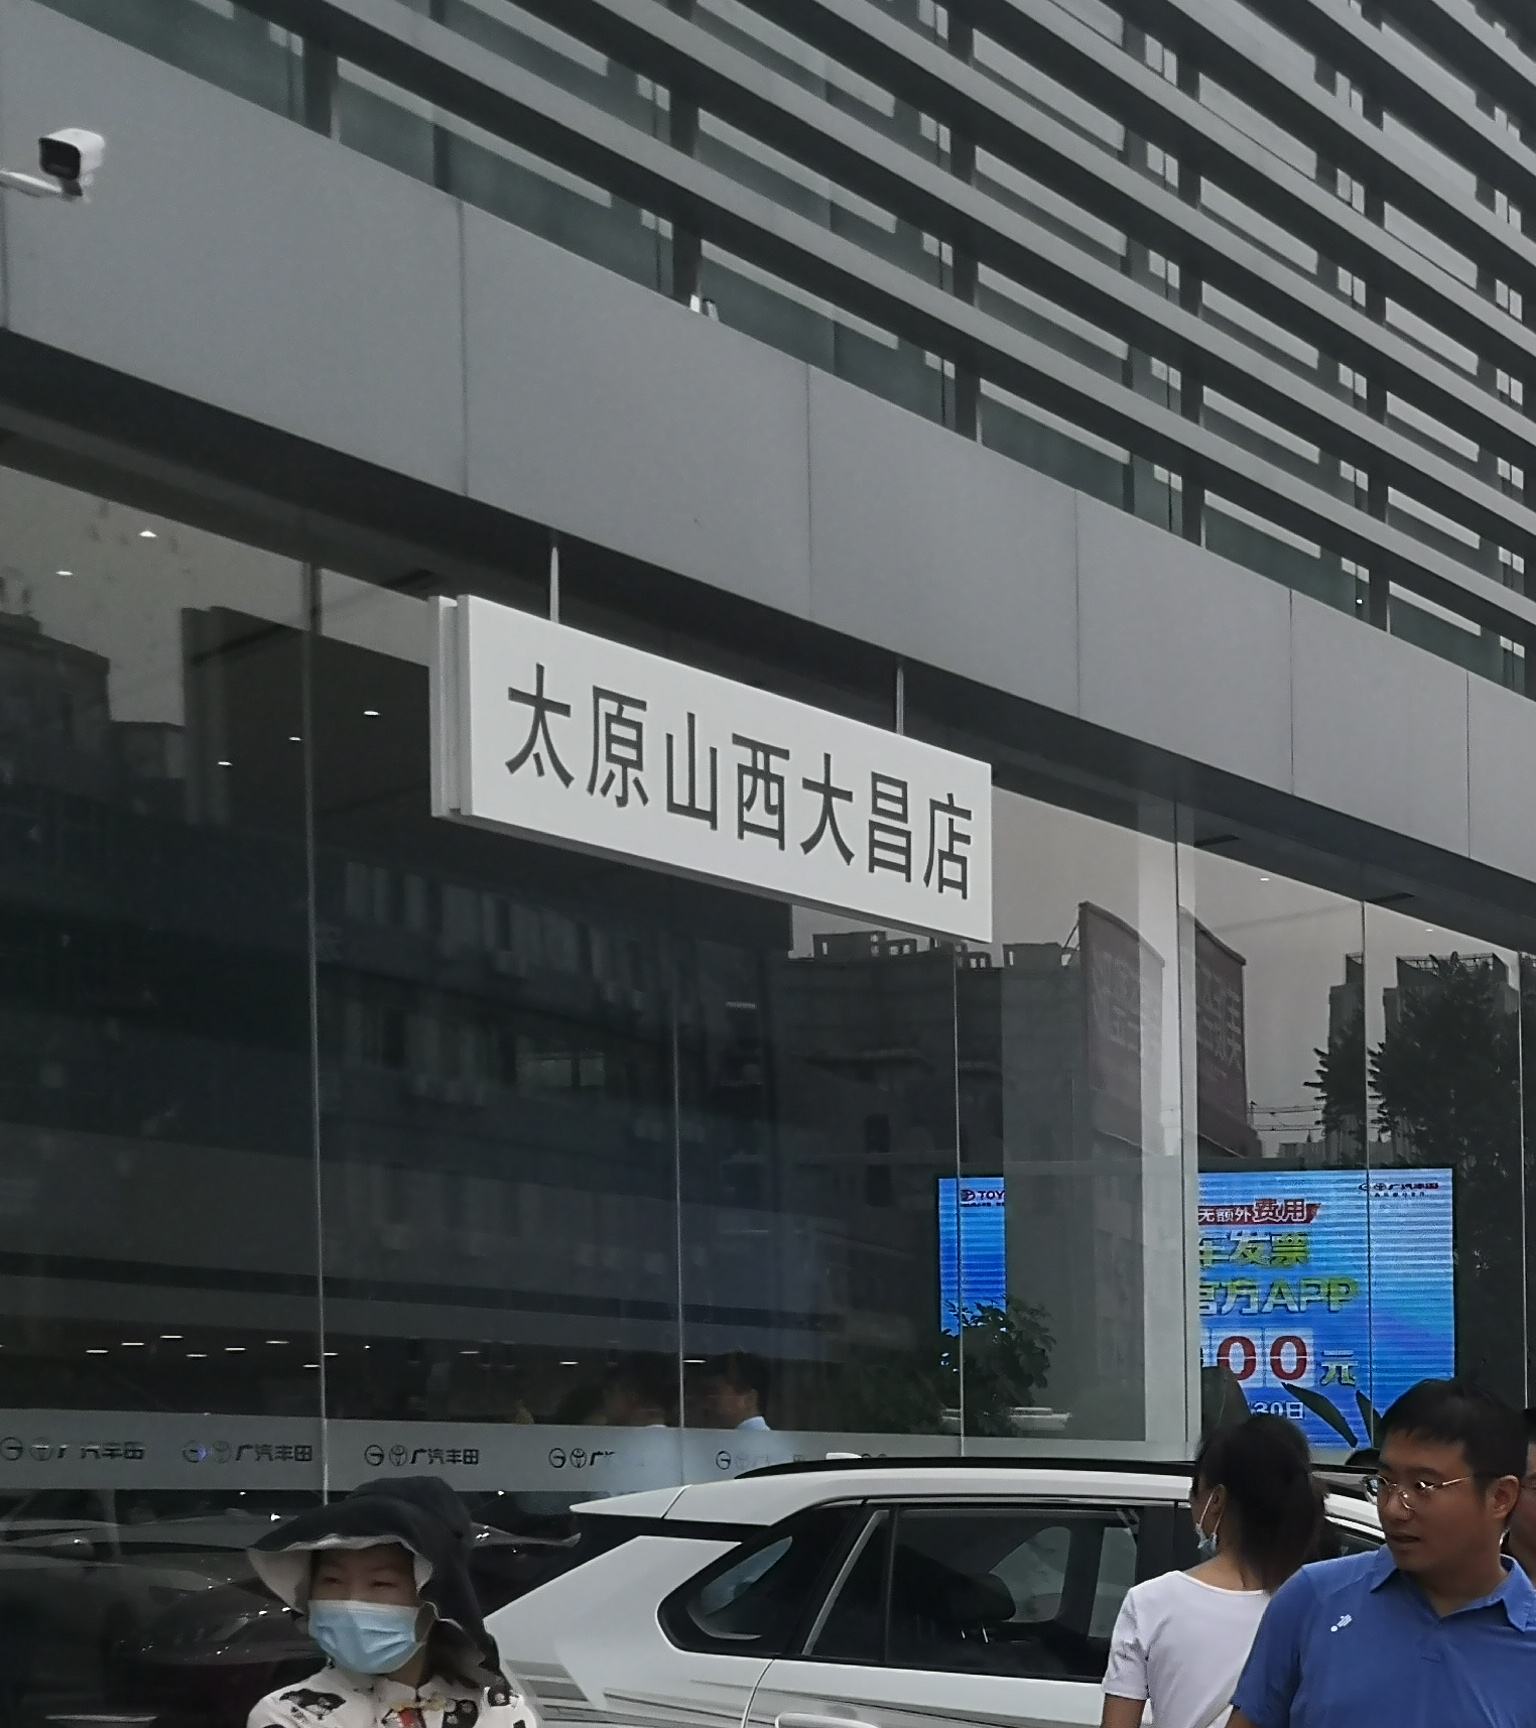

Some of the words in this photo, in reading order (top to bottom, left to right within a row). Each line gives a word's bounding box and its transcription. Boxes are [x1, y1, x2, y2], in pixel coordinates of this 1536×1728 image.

[504, 662, 973, 900] 太原山西大昌店
[1199, 1198, 1308, 1223] 无额外费用
[235, 1443, 313, 1463] 广汽丰田
[410, 1447, 480, 1466] 广汽丰田
